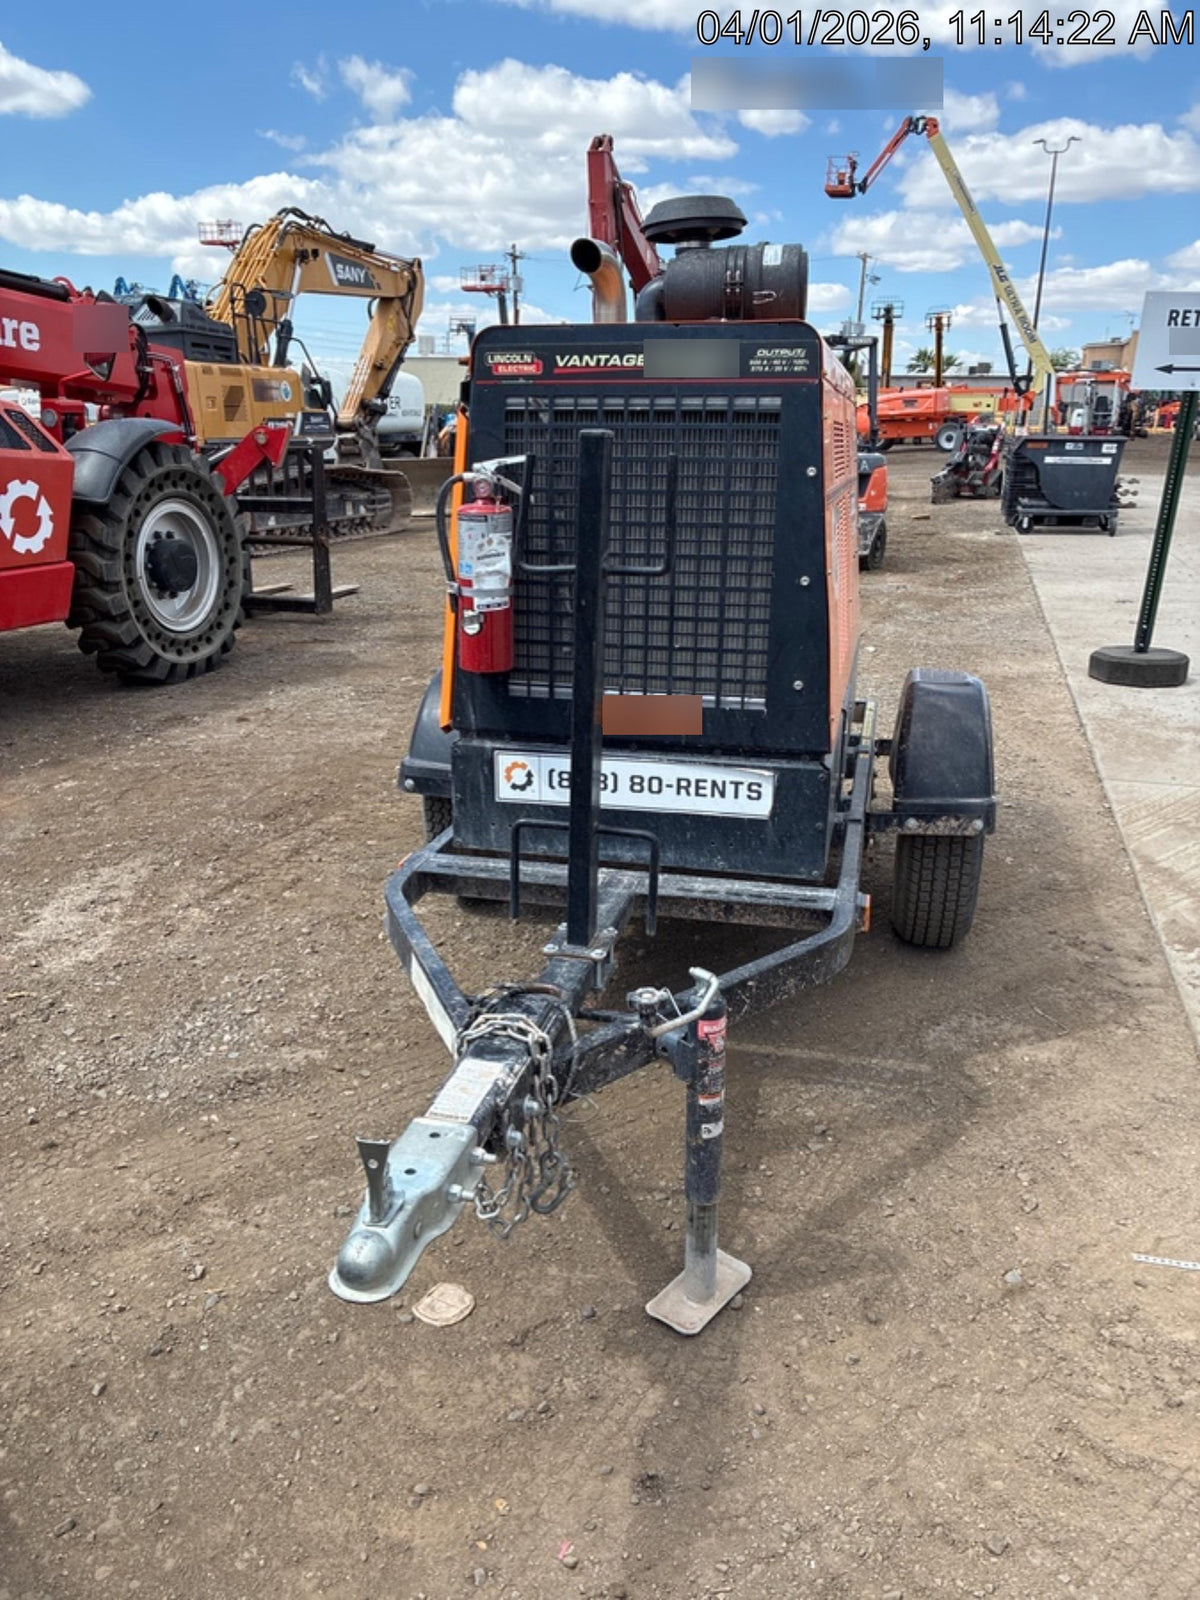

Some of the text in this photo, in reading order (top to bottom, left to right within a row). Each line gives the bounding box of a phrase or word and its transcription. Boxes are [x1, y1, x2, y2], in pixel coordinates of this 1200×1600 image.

[335, 263, 367, 284] SANY
[992, 264, 1008, 282] JLG
[487, 353, 533, 364] LINCOLN
[497, 364, 538, 373] ELECTRIC
[629, 775, 763, 801] 80-RENTS
